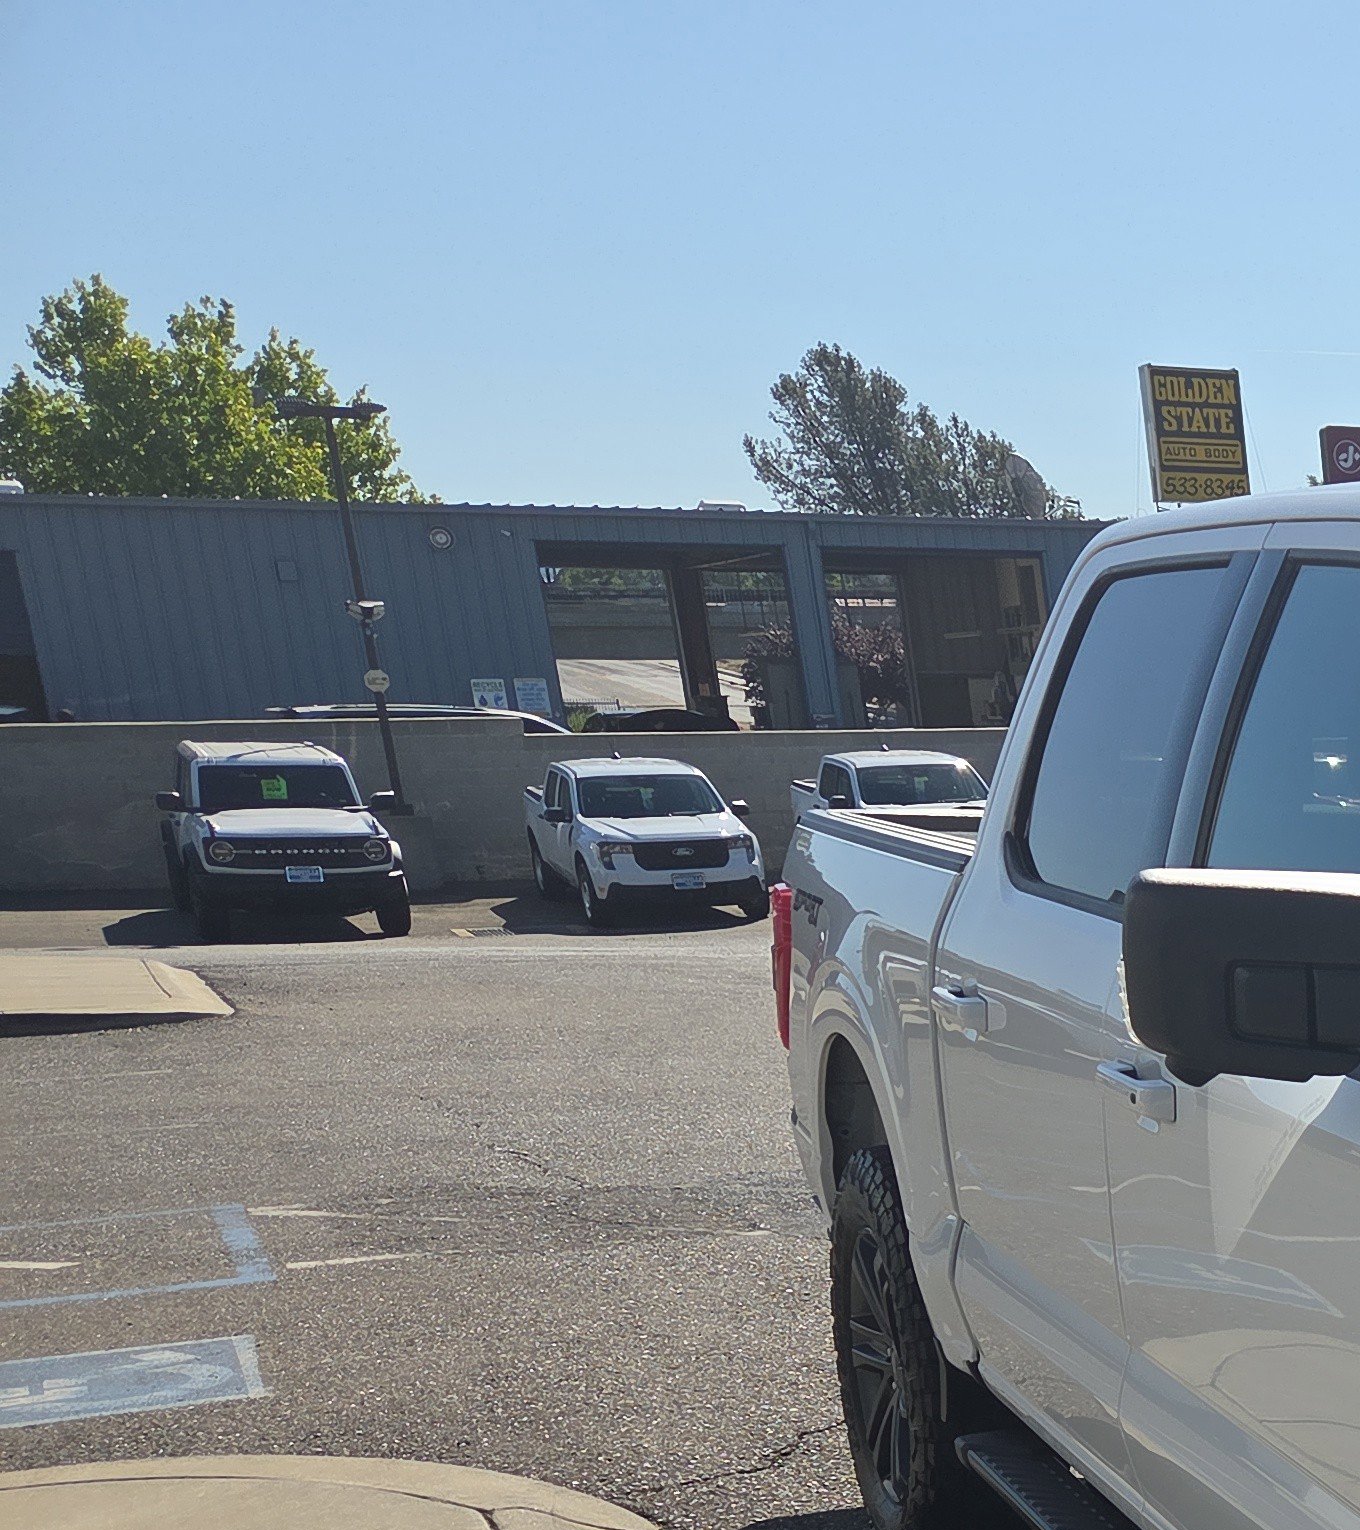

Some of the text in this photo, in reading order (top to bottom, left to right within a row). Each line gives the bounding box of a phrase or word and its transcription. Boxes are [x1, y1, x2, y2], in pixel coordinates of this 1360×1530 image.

[1153, 375, 1237, 405] GOLDEN
[1161, 405, 1235, 434] STATE
[1164, 446, 1238, 460] AUTO BODY
